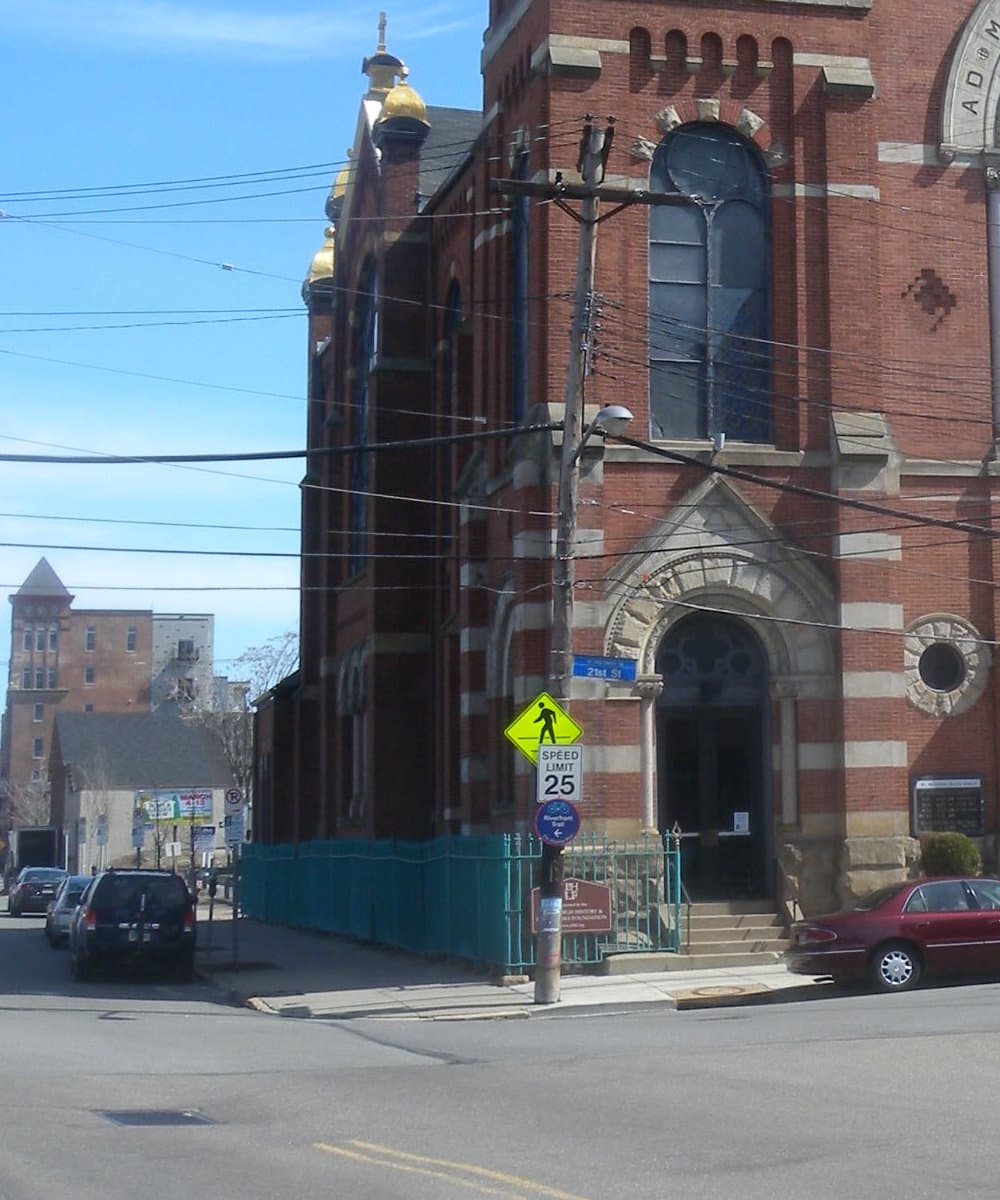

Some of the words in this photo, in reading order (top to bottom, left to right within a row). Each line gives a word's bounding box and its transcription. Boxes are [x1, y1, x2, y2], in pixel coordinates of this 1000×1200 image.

[962, 70, 984, 116] AD
[587, 667, 608, 678] 21st
[611, 669, 622, 679] St
[542, 751, 579, 760] SPEED
[546, 763, 574, 772] LIMIT
[544, 774, 575, 795] 25
